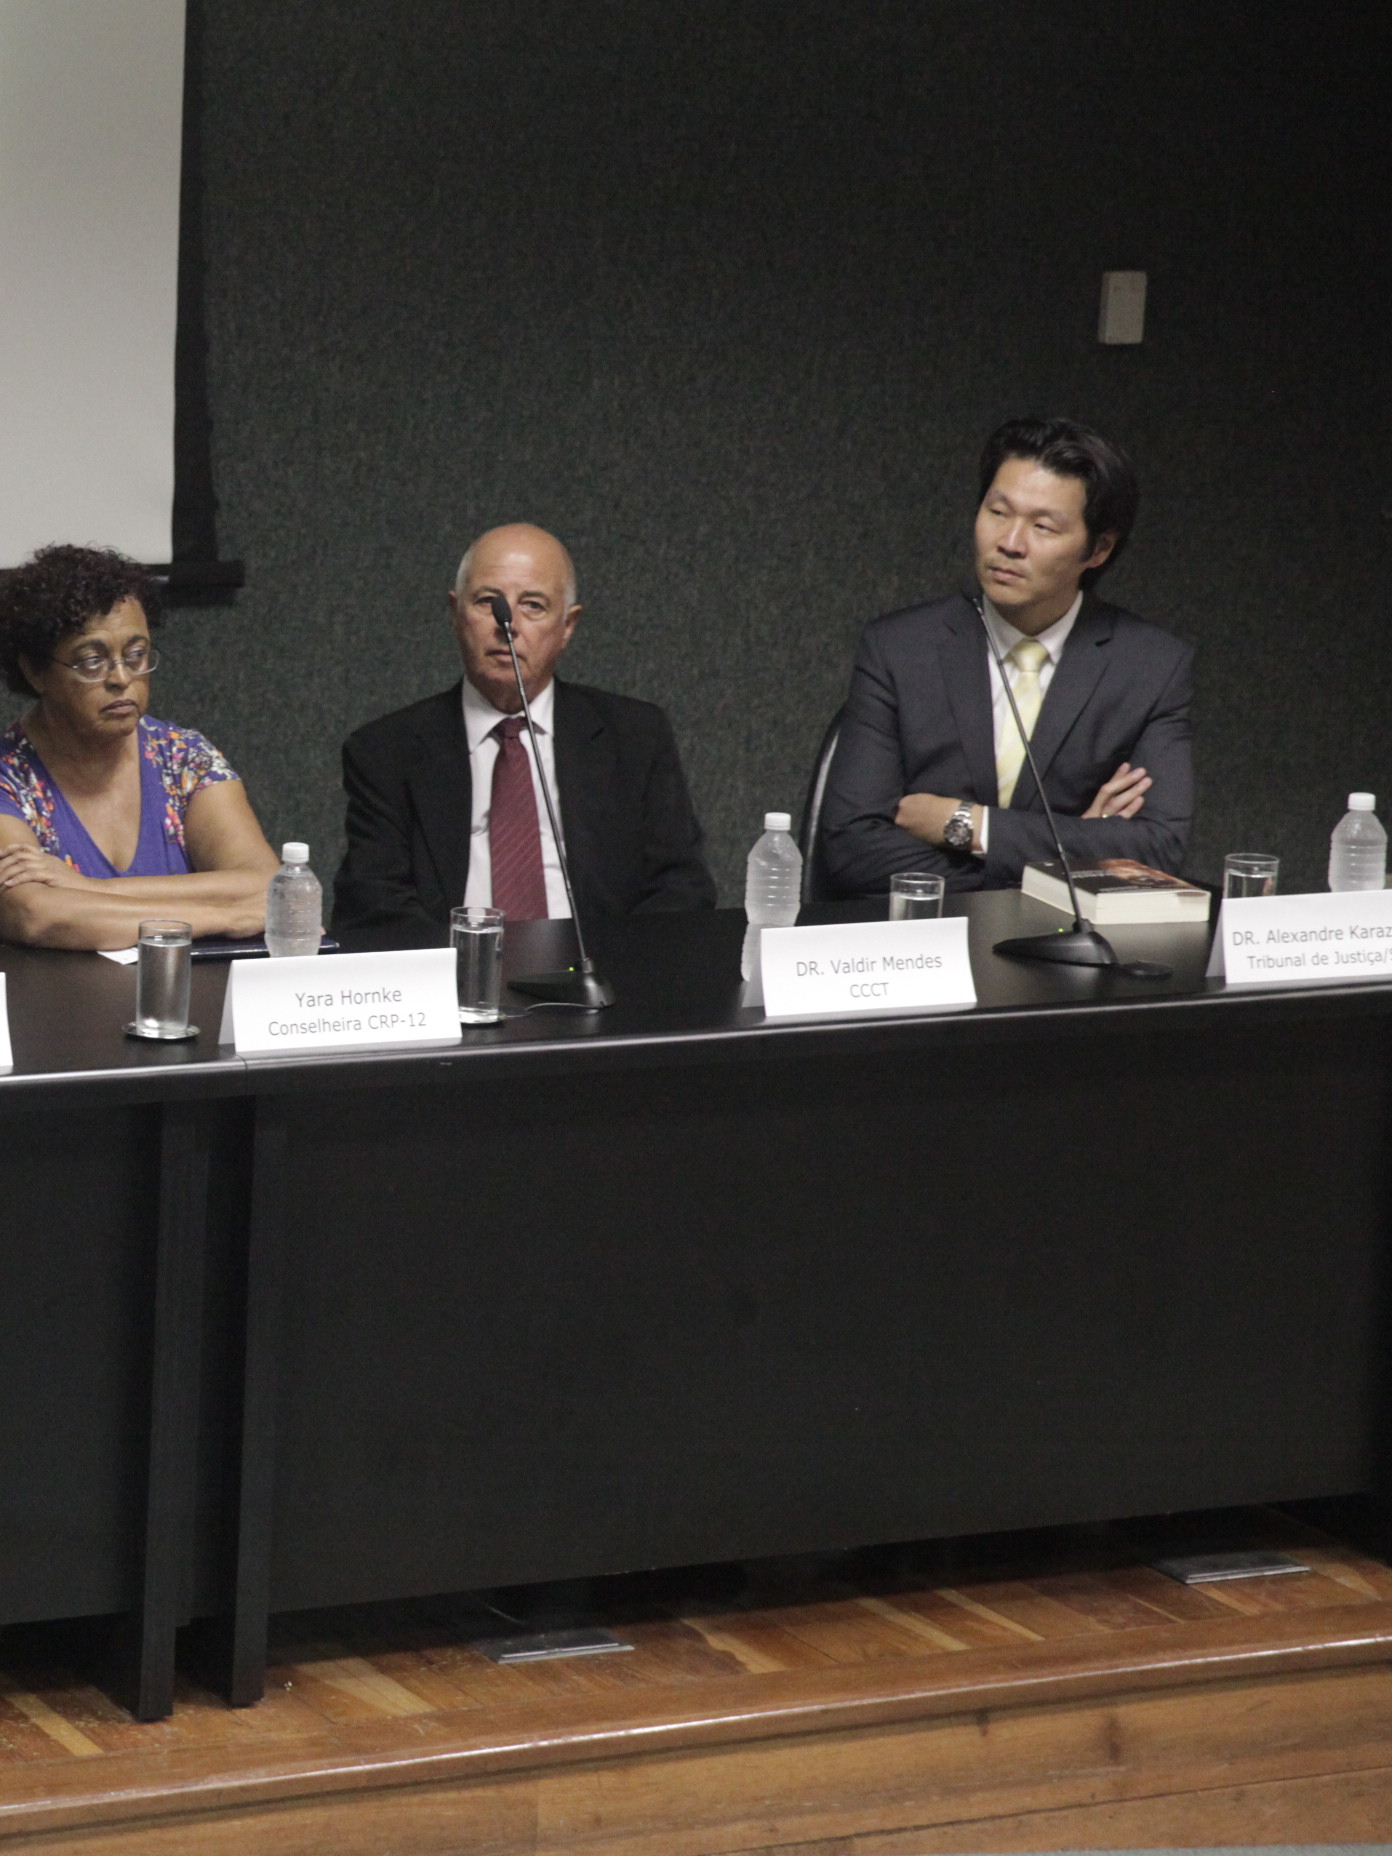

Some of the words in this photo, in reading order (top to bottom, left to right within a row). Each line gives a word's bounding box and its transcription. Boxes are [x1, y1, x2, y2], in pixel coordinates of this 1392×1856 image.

[1232, 931, 1259, 946] DR.
[1266, 927, 1344, 944] Alexandre
[797, 961, 824, 977] DR.
[830, 958, 876, 974] Valdir
[883, 954, 942, 971] Mendes
[1247, 955, 1305, 969] Tribunal
[1311, 952, 1329, 966] de
[295, 992, 333, 1007] Yara
[341, 988, 402, 1005] Hornke
[850, 982, 889, 998] CCCT
[268, 1017, 362, 1036] Conselheira
[368, 1013, 426, 1030] CRP-12
